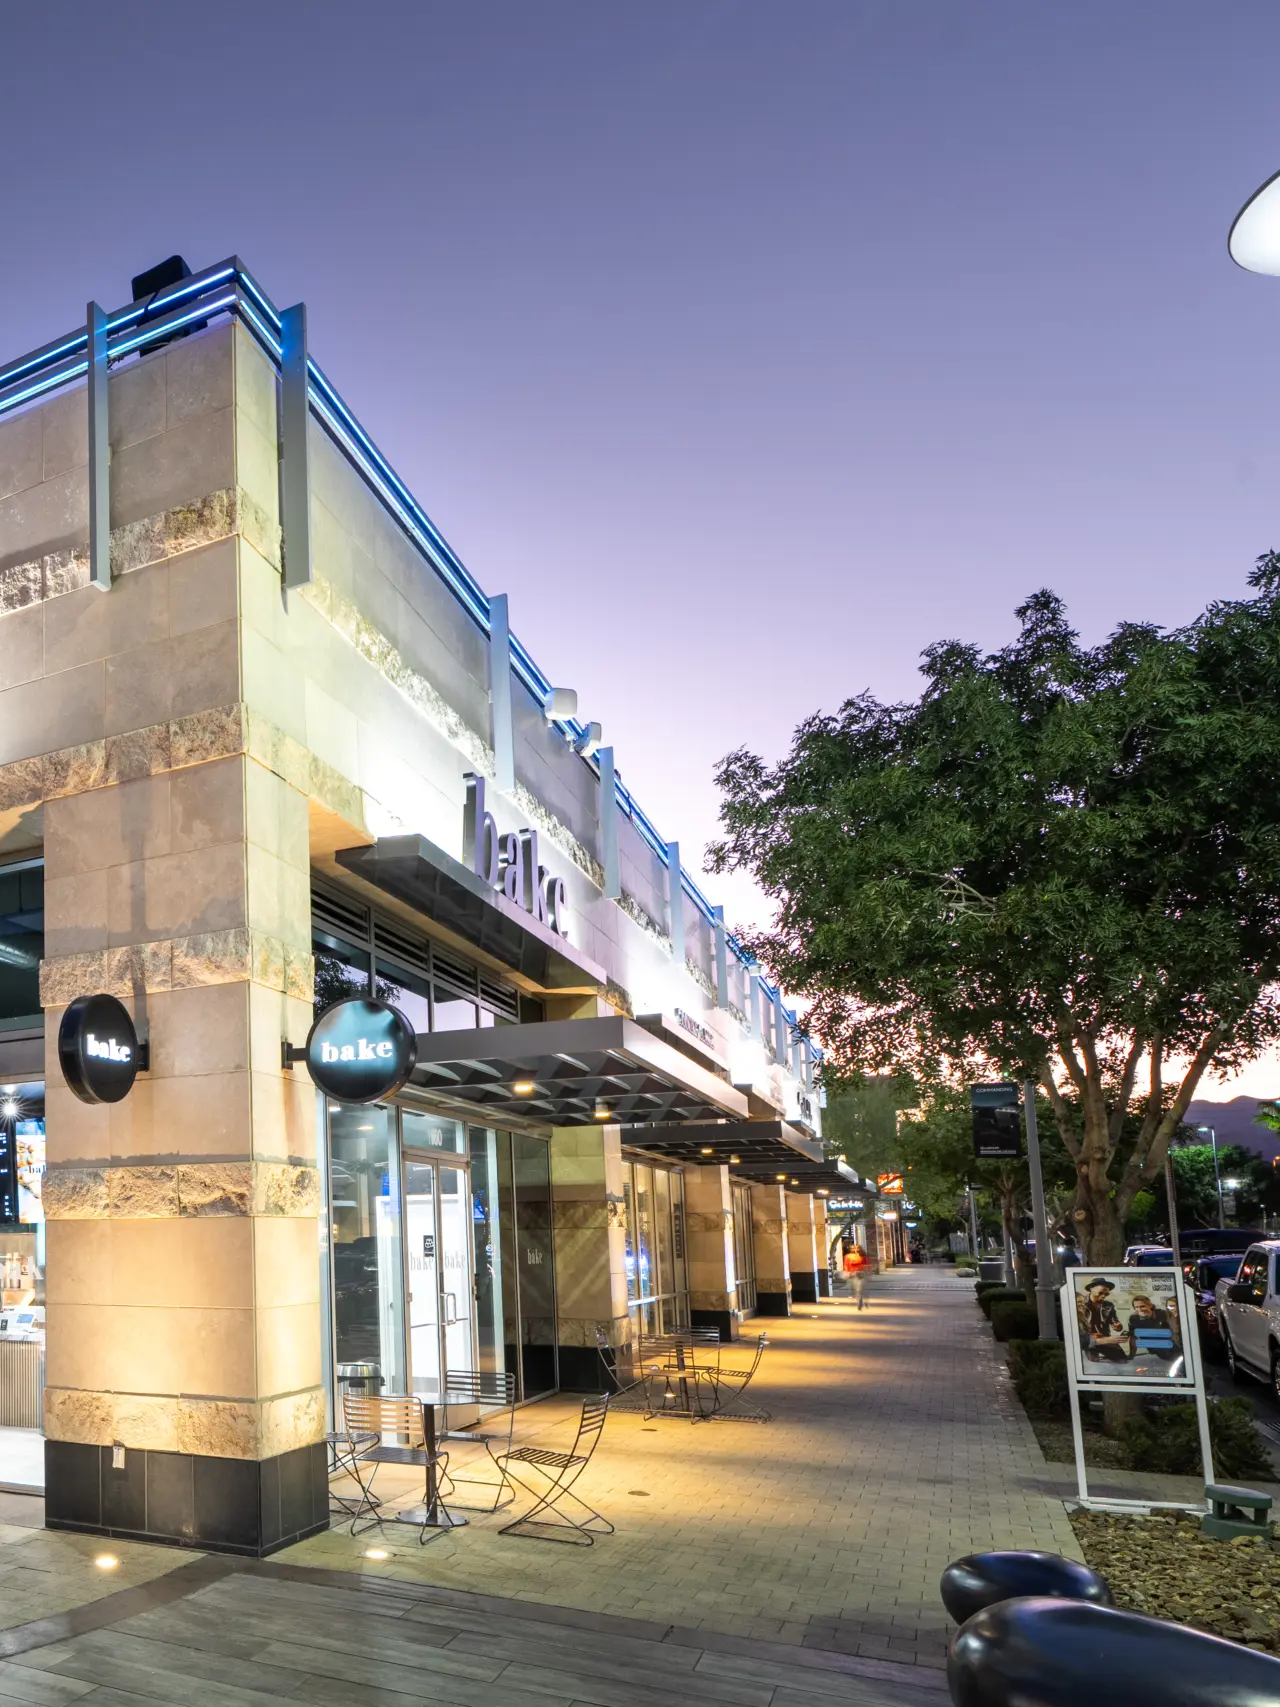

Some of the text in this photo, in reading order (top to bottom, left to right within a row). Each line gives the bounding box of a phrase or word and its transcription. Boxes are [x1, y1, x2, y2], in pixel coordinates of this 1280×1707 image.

[463, 772, 571, 939] bake
[86, 1033, 131, 1063] bake
[320, 1037, 393, 1063] bake
[410, 1252, 434, 1271] bake
[444, 1251, 466, 1269] bake
[527, 1248, 543, 1265] bake
